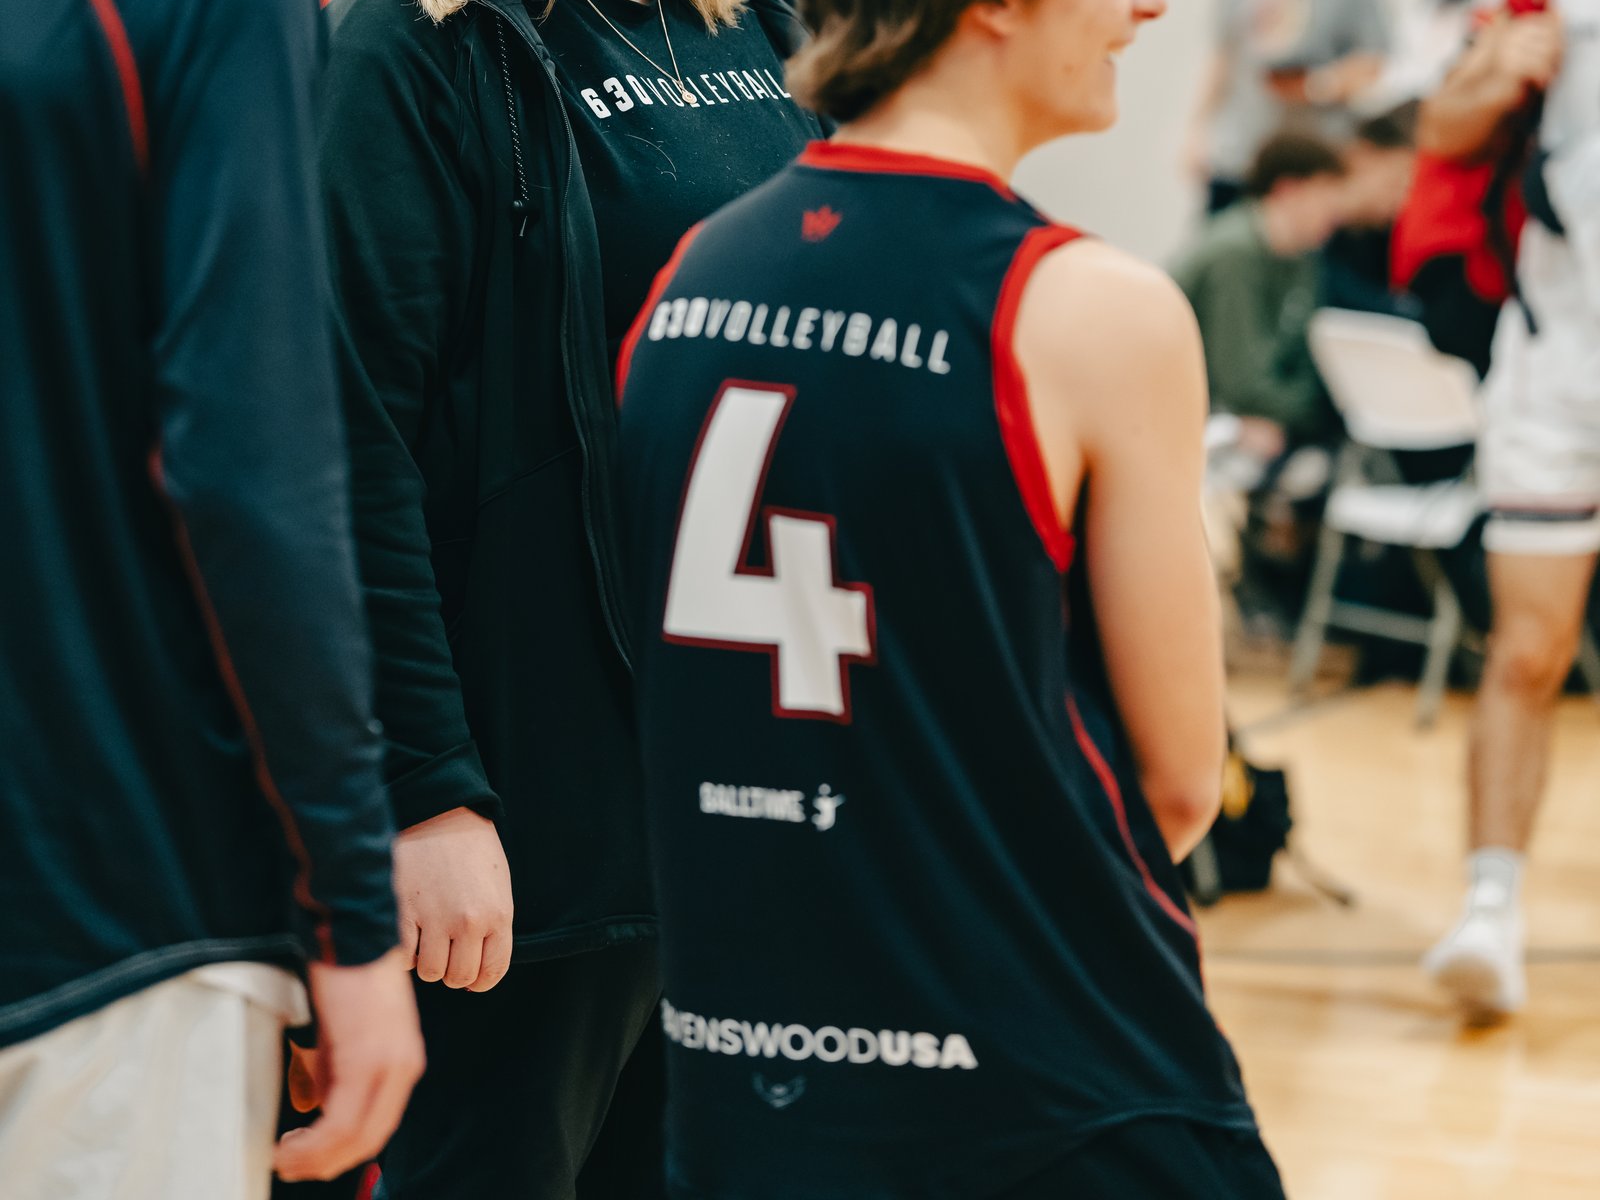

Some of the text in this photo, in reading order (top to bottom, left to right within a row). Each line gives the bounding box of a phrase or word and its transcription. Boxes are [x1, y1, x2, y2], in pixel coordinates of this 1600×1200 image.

[580, 68, 792, 119] 630VOLLEYBALL
[648, 296, 951, 375] 630VOLLEYBALL
[662, 377, 878, 724] 4
